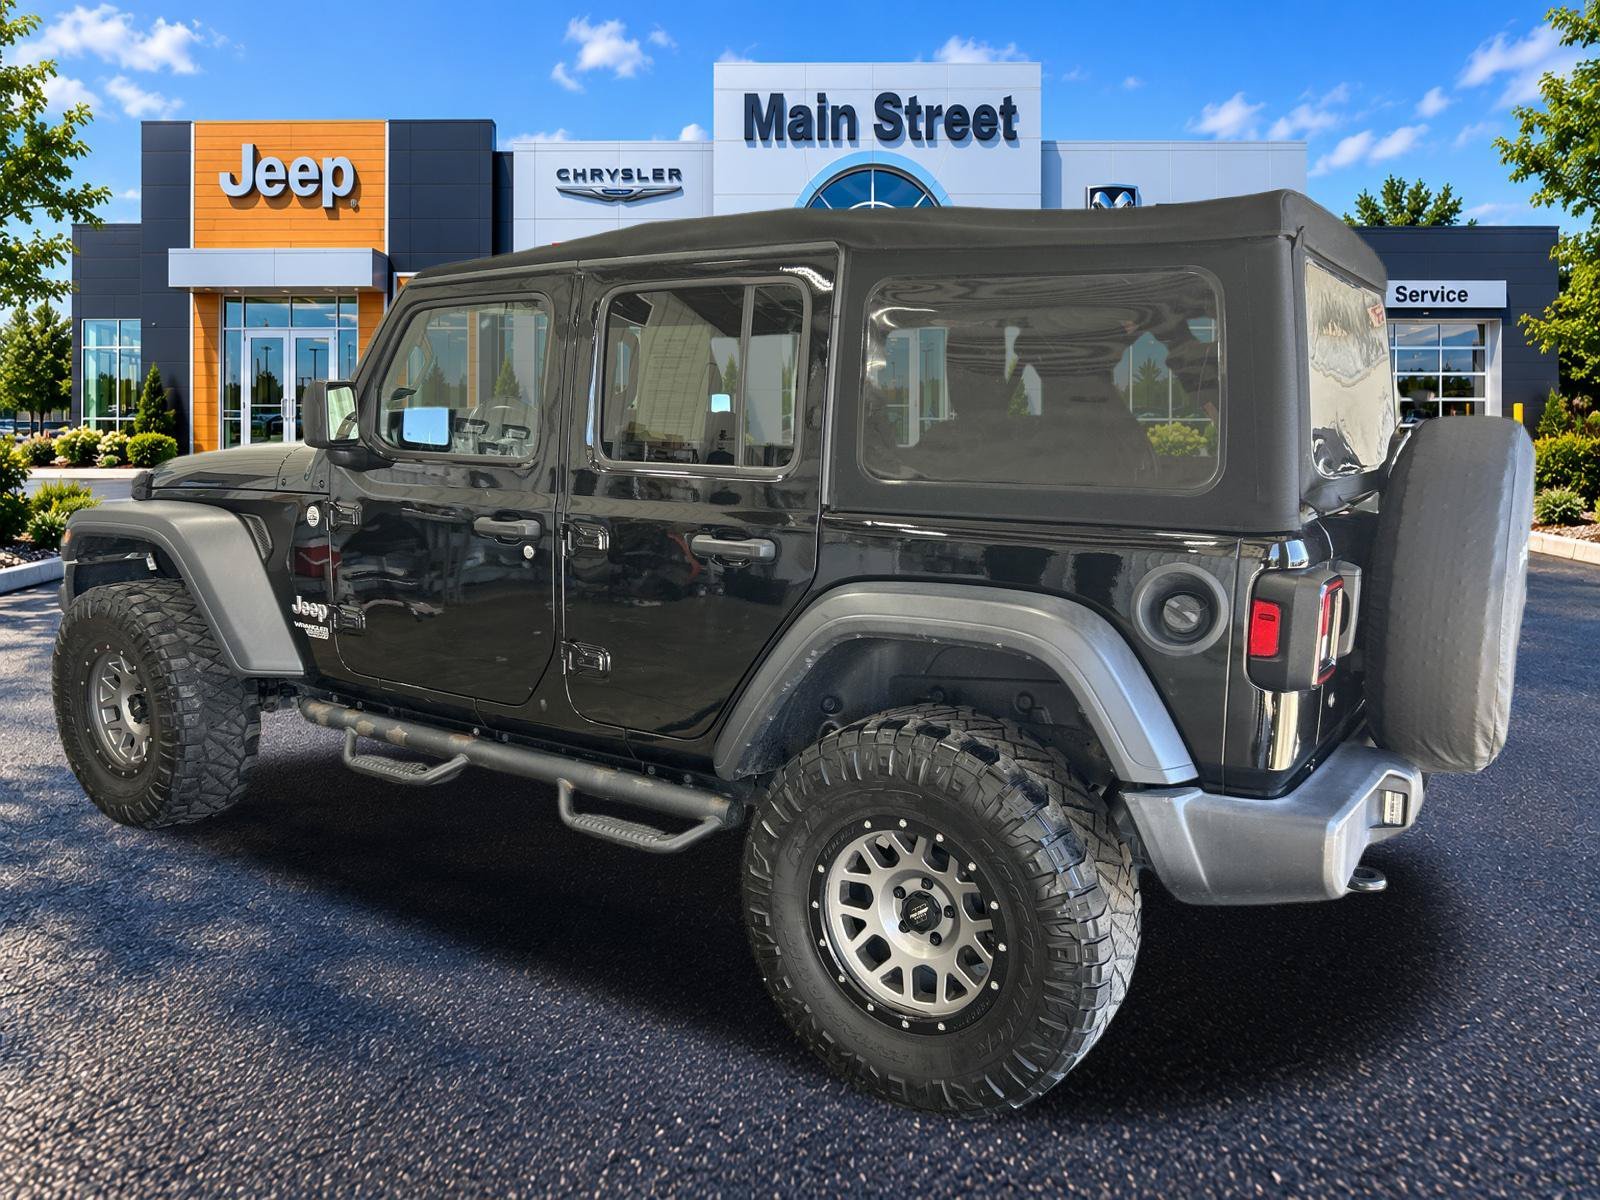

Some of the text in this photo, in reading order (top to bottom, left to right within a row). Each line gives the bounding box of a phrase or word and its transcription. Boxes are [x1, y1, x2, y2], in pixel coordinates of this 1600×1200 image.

[744, 91, 1018, 142] Main Street
[218, 143, 355, 208] Jeep
[556, 167, 683, 182] CHRYSLER
[1395, 285, 1469, 303] Service
[291, 595, 327, 623] Jeep
